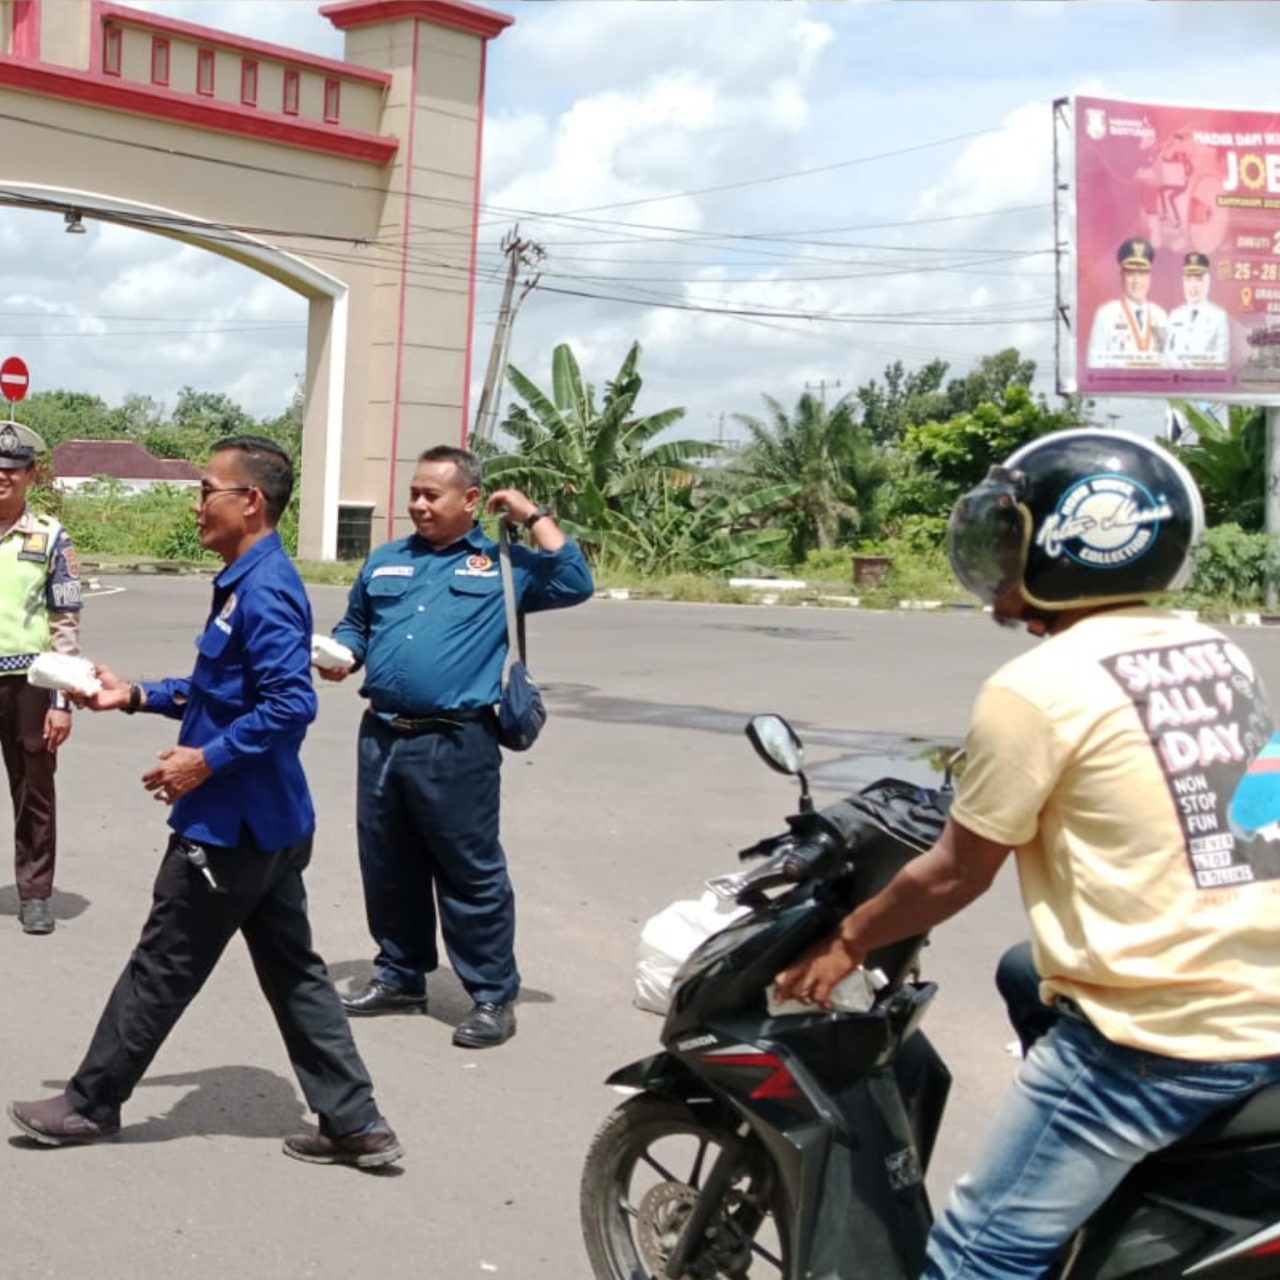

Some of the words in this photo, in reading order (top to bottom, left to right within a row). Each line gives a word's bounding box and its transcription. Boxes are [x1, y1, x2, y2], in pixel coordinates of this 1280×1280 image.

[1115, 642, 1233, 692] SKATE
[1147, 685, 1219, 733] ALL
[1158, 722, 1246, 772] DAY
[1173, 773, 1208, 794] NON
[1180, 791, 1218, 814] STOP
[1187, 813, 1219, 835] FUN
